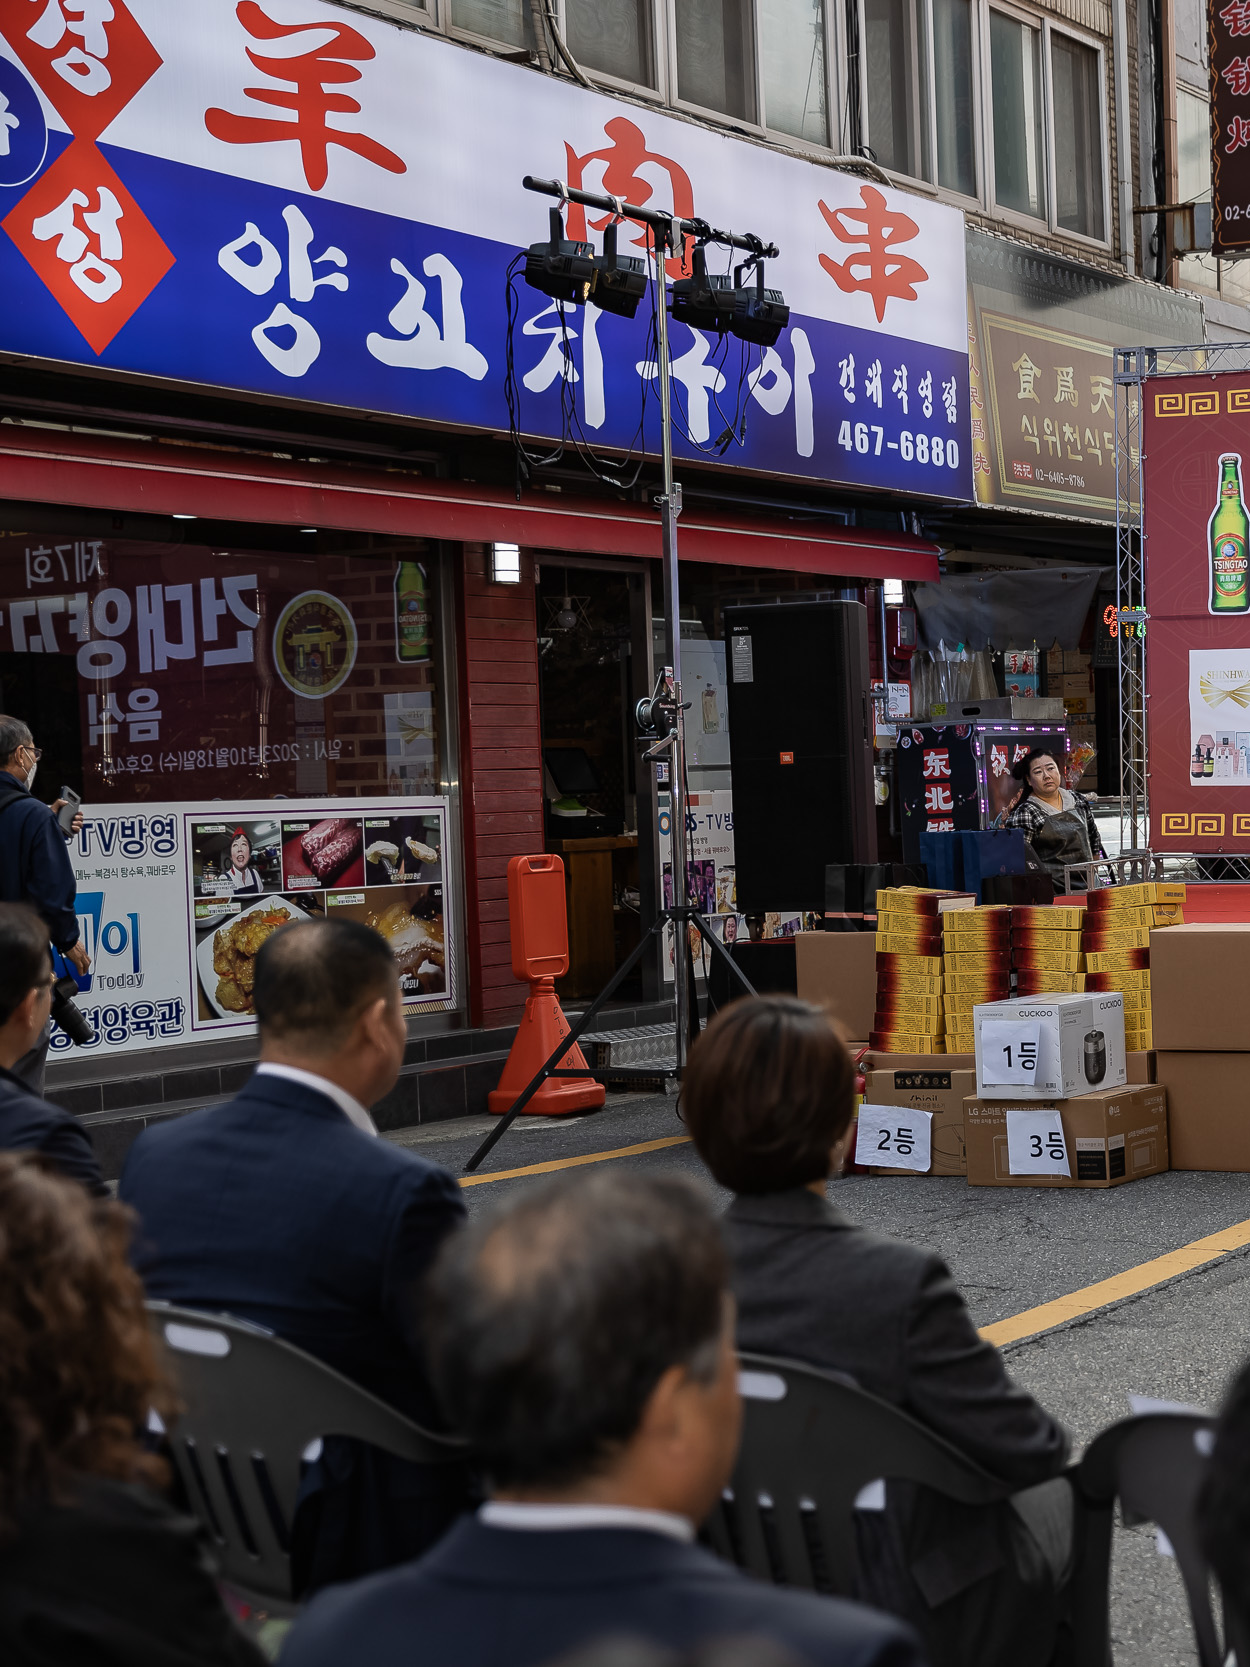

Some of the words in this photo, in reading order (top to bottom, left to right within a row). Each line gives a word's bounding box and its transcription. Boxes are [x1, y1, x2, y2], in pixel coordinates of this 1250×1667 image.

[204, 0, 930, 324] 羊肉串
[839, 353, 957, 423] 건대직영점
[838, 420, 959, 469] 467-6880
[1021, 414, 1119, 468] 식위천식당
[1035, 468, 1085, 487] 02-6405-8786
[1214, 560, 1248, 570] TSINGTAO
[70, 815, 177, 857] TV방영
[97, 971, 145, 990] Today
[1018, 1010, 1053, 1018] CUCKOO
[1099, 999, 1122, 1011] CUCKOO
[1003, 1042, 1037, 1071] 1등
[968, 1107, 979, 1116] LG
[980, 1107, 1001, 1116] 스마트
[877, 1127, 915, 1155] 2등
[1029, 1131, 1065, 1161] 3등
